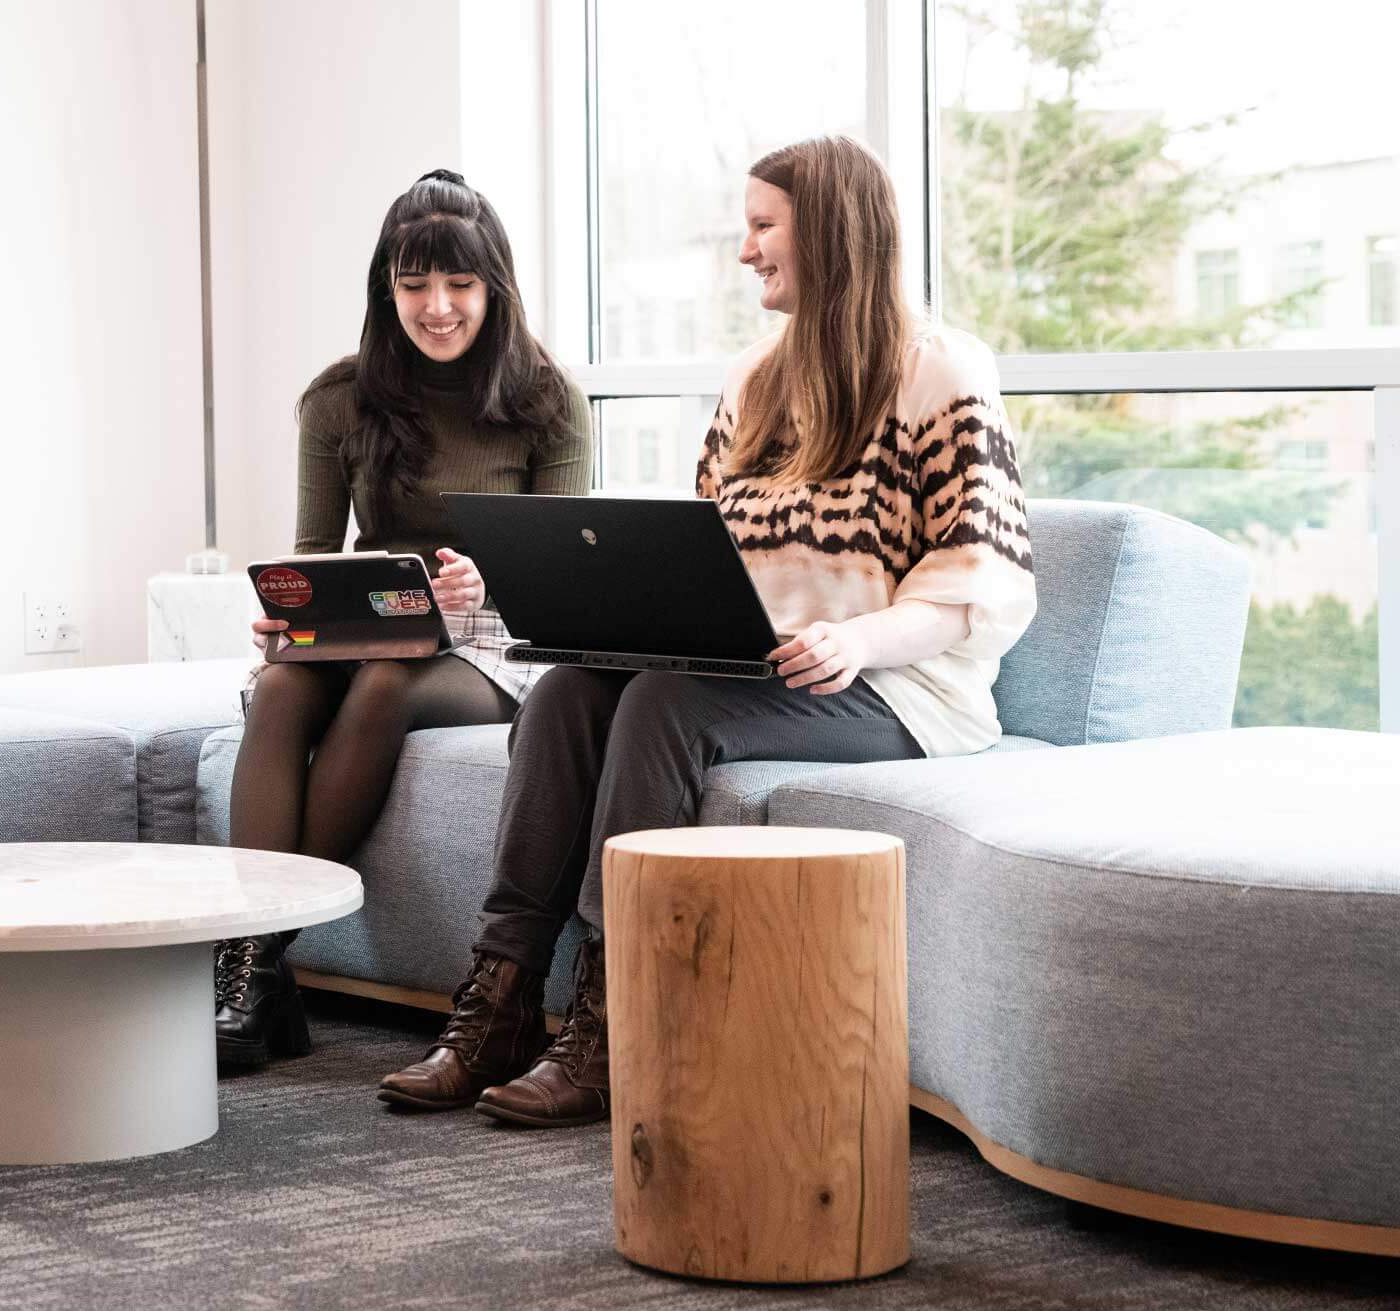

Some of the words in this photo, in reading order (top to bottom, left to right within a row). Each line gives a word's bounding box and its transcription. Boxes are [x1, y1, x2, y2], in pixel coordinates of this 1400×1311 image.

[260, 580, 309, 591] PROUD
[369, 590, 427, 601] GAME
[373, 599, 430, 610] OVER
